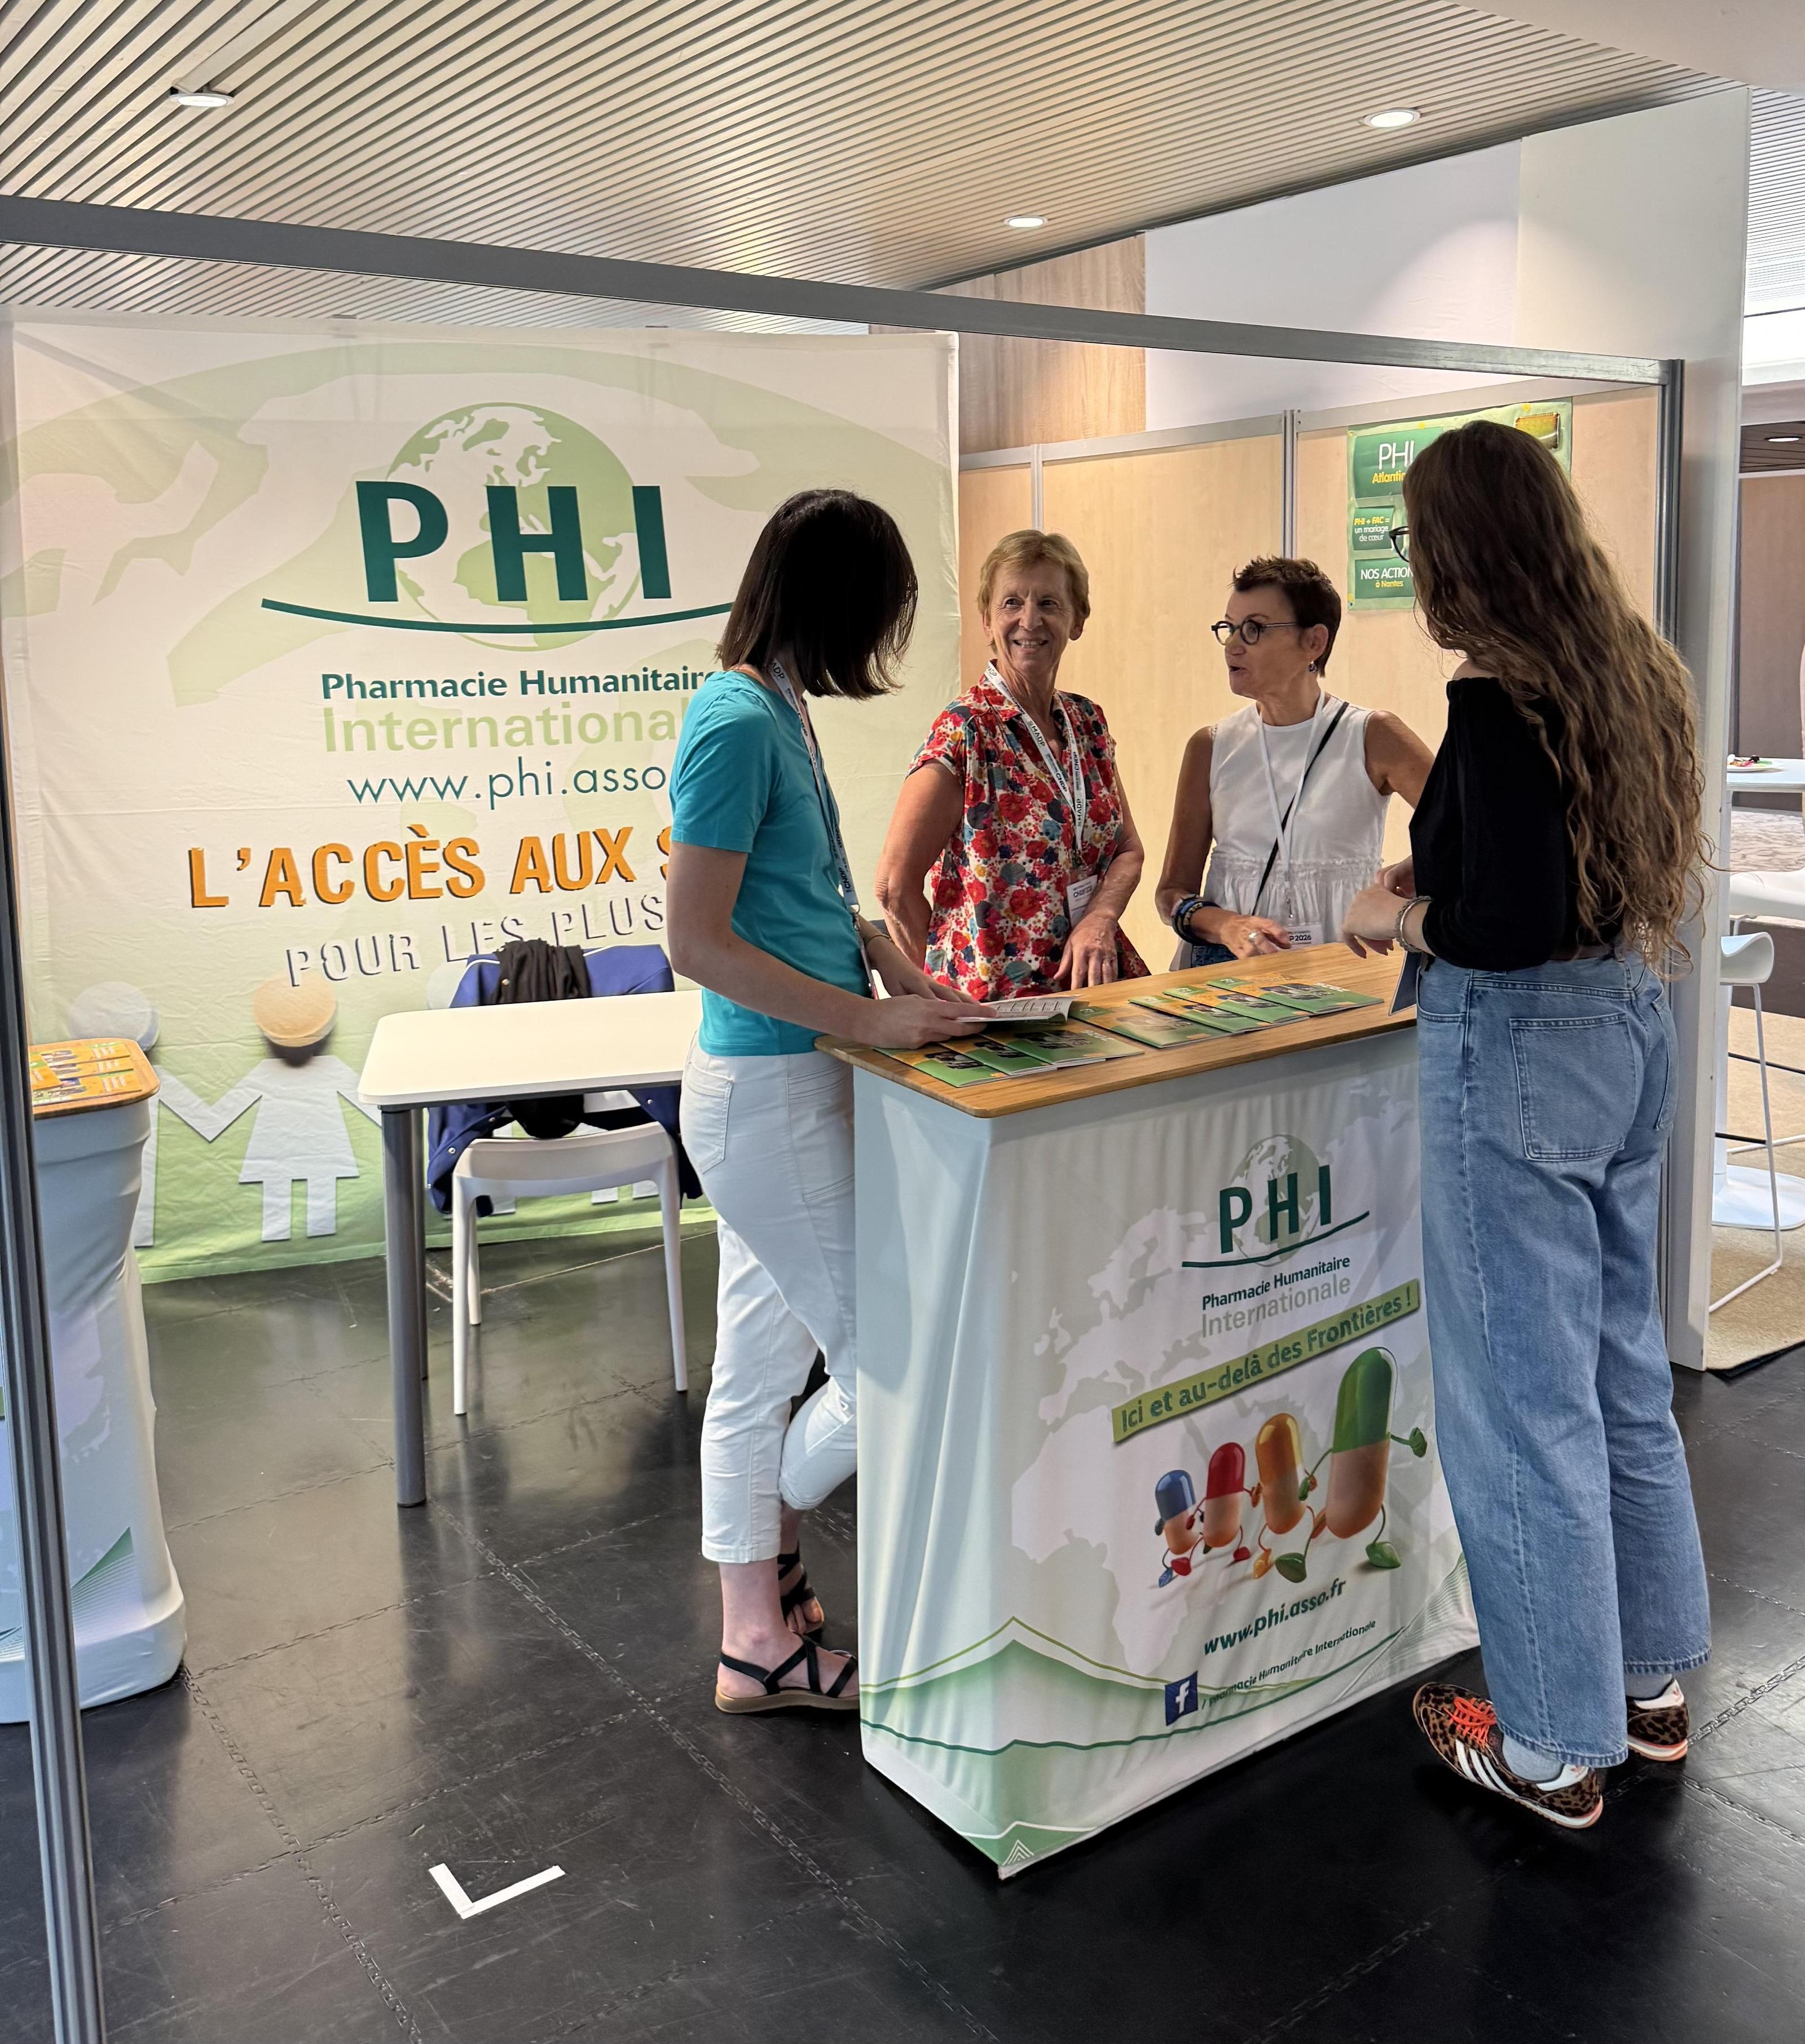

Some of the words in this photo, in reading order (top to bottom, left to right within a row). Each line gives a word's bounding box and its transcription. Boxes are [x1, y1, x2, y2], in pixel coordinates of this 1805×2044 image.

[1372, 470, 1406, 484] Atlanti
[1378, 440, 1415, 470] PHI
[356, 481, 672, 602] PHI
[1363, 525, 1389, 534] mariage
[1361, 569, 1380, 580] NOS
[1381, 567, 1414, 579] ACTION
[322, 671, 508, 699] Pharmacie
[772, 662, 785, 679] ADP
[323, 697, 689, 752] Internationa
[346, 756, 666, 810] www.phi.asso
[188, 823, 486, 908] L'ACCÈS
[509, 826, 637, 894] AUX
[286, 932, 422, 987] POUR
[442, 916, 526, 962] LES
[551, 893, 668, 948] PLUS
[1219, 1164, 1332, 1254] PHI
[1202, 1281, 1270, 1310] Pharmacie
[1274, 1257, 1350, 1289] Humanitaire
[1202, 1274, 1351, 1338] Internationale
[1121, 1400, 1143, 1433] Ici
[1150, 1390, 1172, 1417] et
[1179, 1355, 1263, 1407] au-delà
[1267, 1343, 1302, 1369] des
[1307, 1295, 1402, 1352] Frontières
[1406, 1286, 1411, 1307] !
[1204, 1578, 1346, 1655] www.phi.asso.fr
[1315, 1619, 1376, 1654] Internationale
